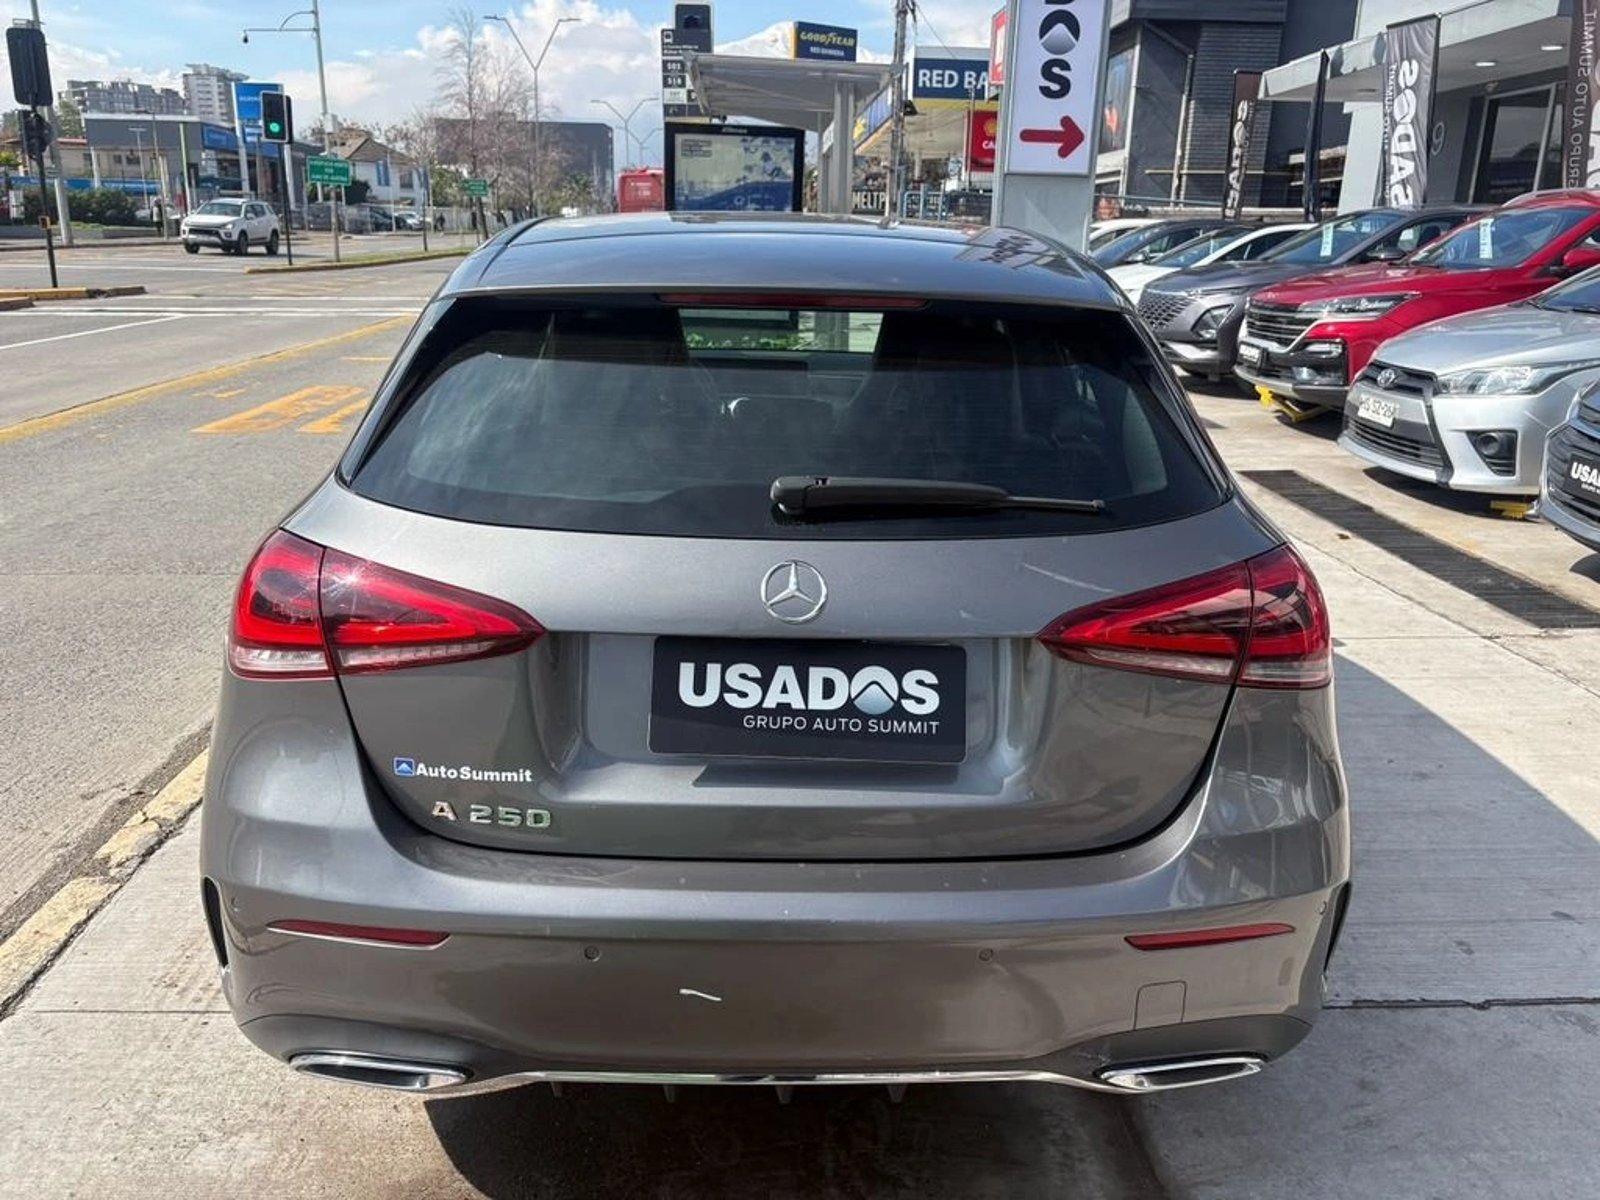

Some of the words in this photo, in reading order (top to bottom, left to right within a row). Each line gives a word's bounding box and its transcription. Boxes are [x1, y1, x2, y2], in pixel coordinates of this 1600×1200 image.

[800, 31, 855, 47] GOODYEAR
[1039, 0, 1081, 99] OS
[918, 69, 958, 88] RED
[1571, 462, 1600, 487] USA
[678, 661, 940, 715] USADOS
[743, 715, 807, 730] GRUPO
[812, 717, 862, 732] AUTO
[868, 719, 940, 735] SUMMIT
[432, 801, 458, 821] A
[470, 804, 550, 828] 250
